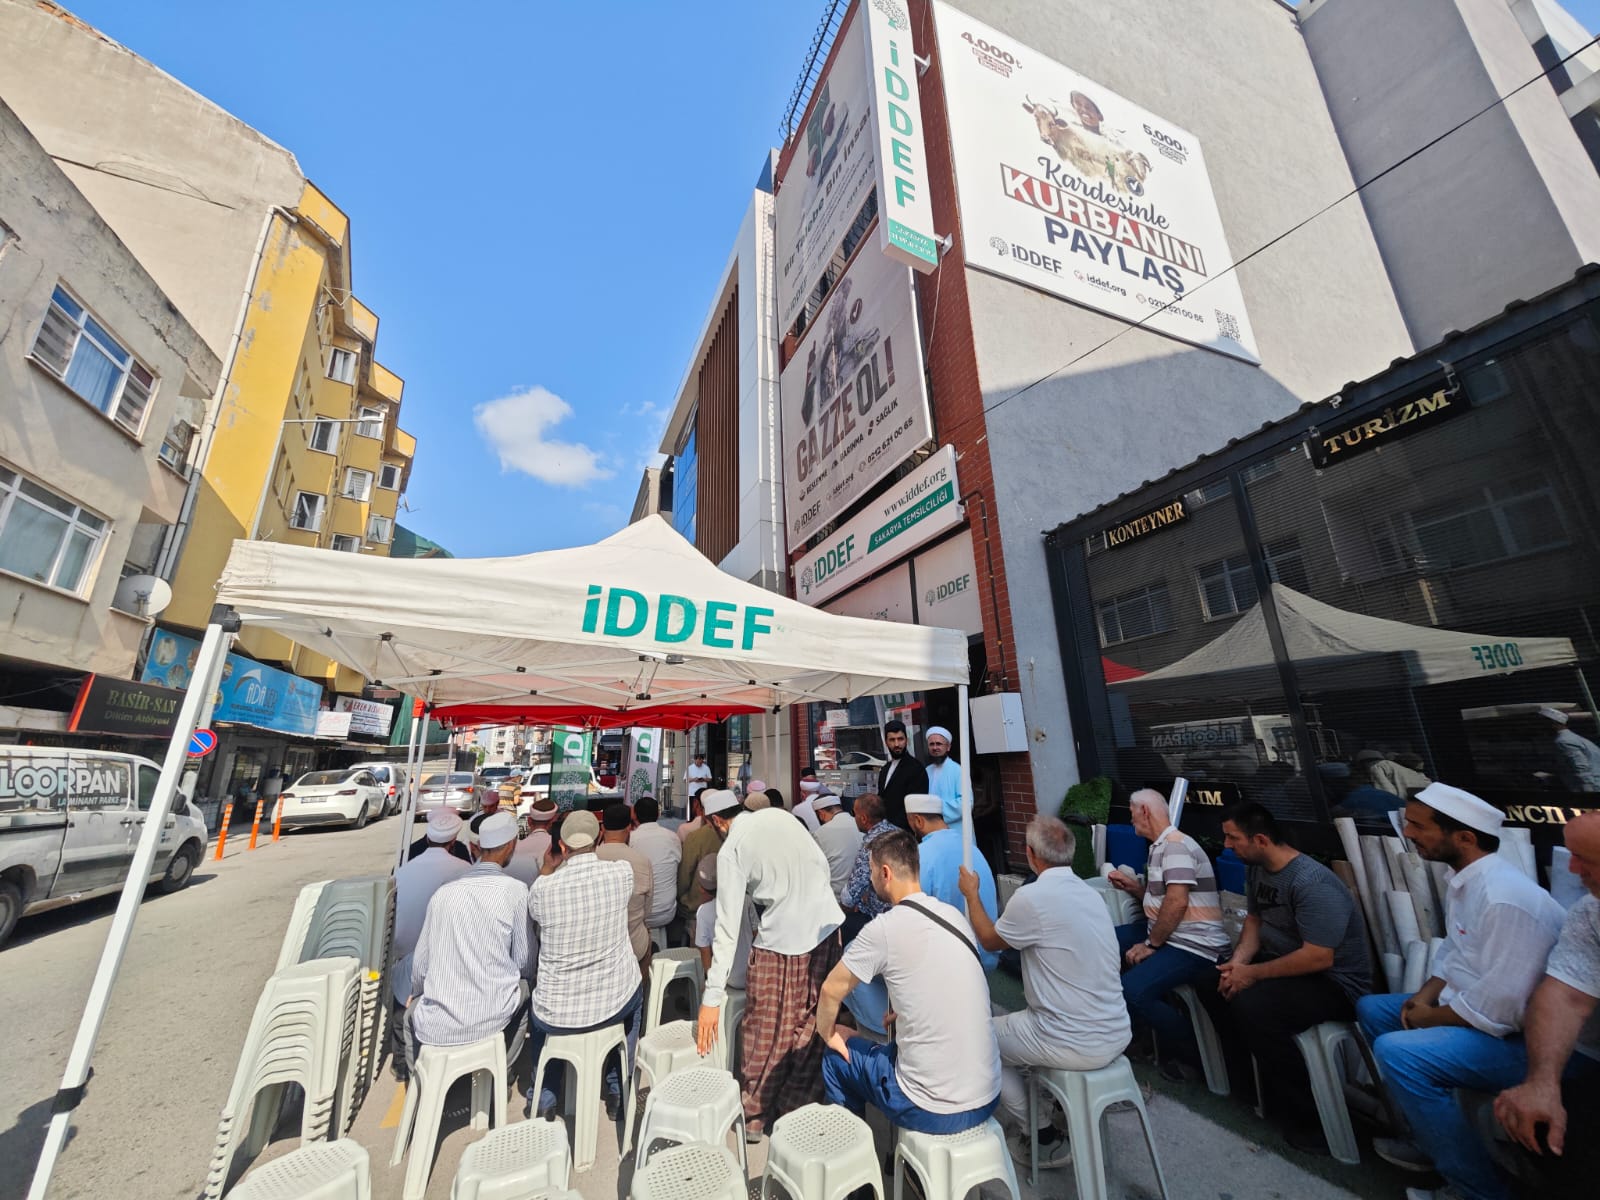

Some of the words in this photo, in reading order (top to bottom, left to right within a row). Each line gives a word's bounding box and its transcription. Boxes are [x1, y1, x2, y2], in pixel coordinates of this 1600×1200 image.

[885, 40, 916, 208] iDDEF
[1002, 164, 1207, 277] KURBANINI
[1037, 156, 1170, 230] Kardeşinle
[1011, 244, 1063, 274] iDDEF
[1044, 216, 1185, 302] PAYLAŞ
[797, 382, 856, 482] GAZZE
[856, 335, 896, 416] OL!
[1323, 389, 1451, 454] TURİZM
[801, 500, 822, 526] iDDEF
[867, 446, 882, 463] 0212
[881, 434, 894, 450] 621
[894, 426, 904, 440] 00
[883, 467, 947, 518] www.iddef.org
[874, 522, 902, 545] SAKARYA
[1108, 502, 1186, 547] KONTEYNER
[814, 534, 855, 583] iDDEF
[936, 573, 970, 600] iDDEF
[582, 584, 775, 650] iDDEF
